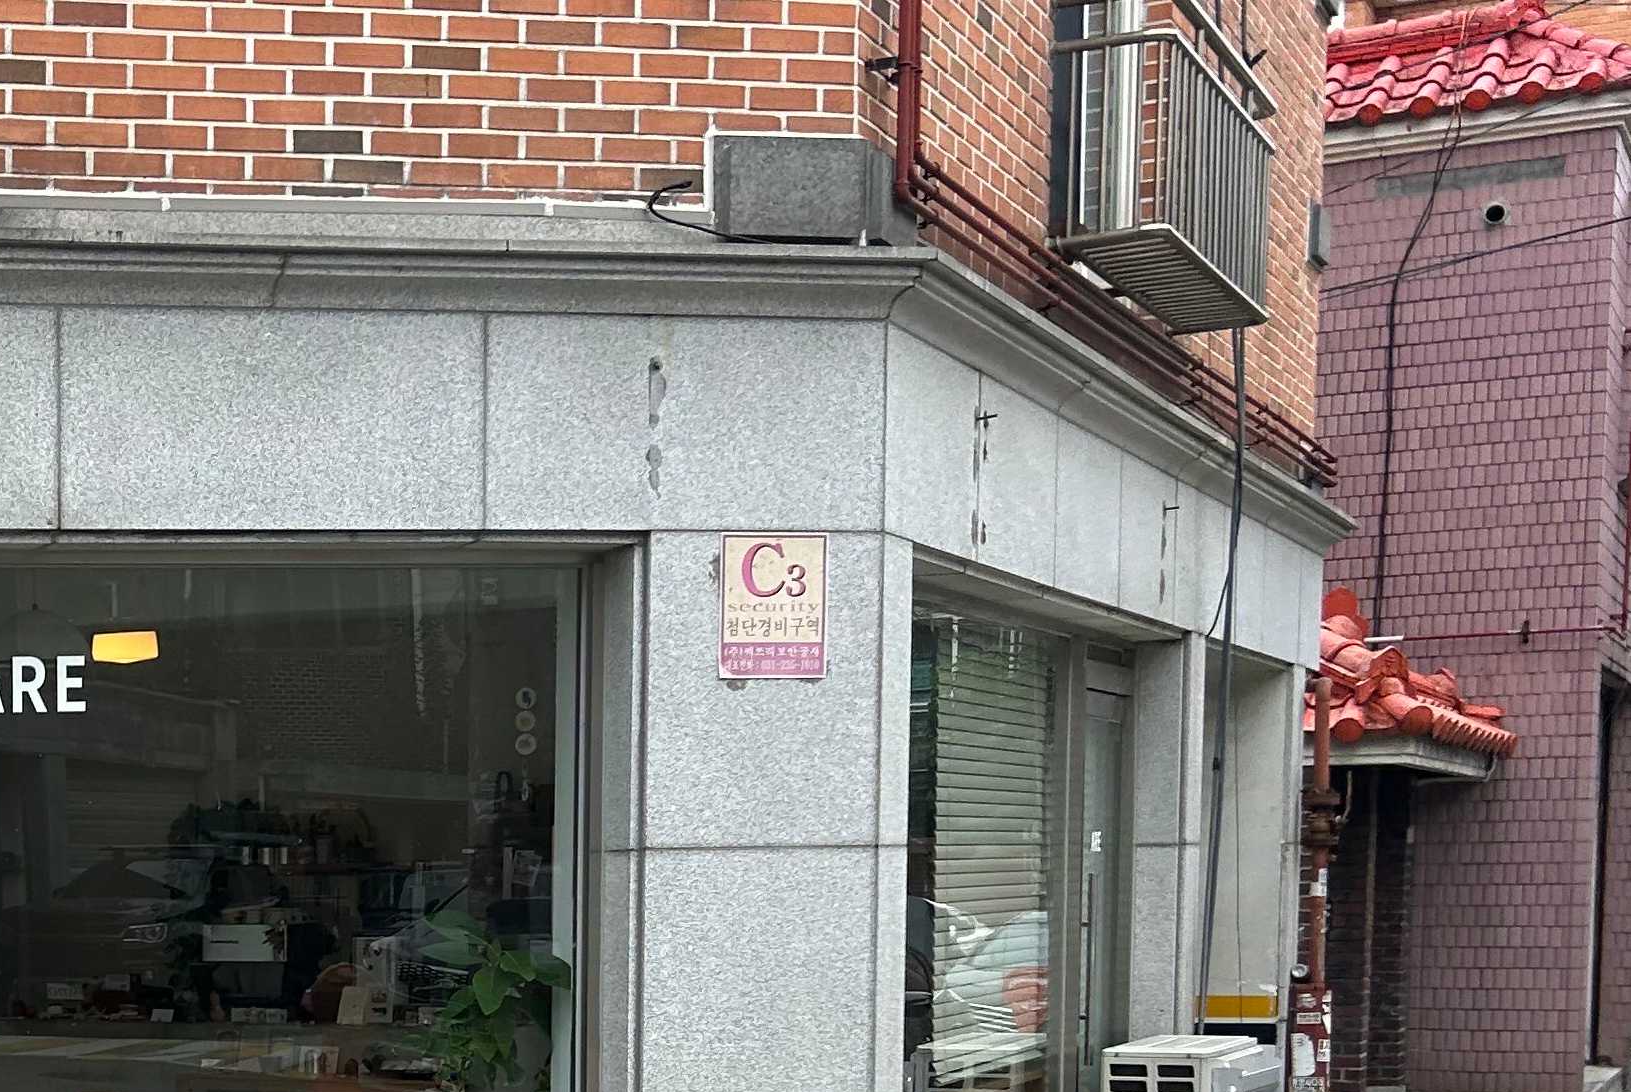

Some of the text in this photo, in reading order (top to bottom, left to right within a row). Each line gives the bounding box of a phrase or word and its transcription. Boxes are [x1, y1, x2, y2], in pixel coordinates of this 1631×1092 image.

[741, 542, 807, 598] C3
[727, 600, 820, 614] security
[726, 616, 819, 637] 첨단경비구역
